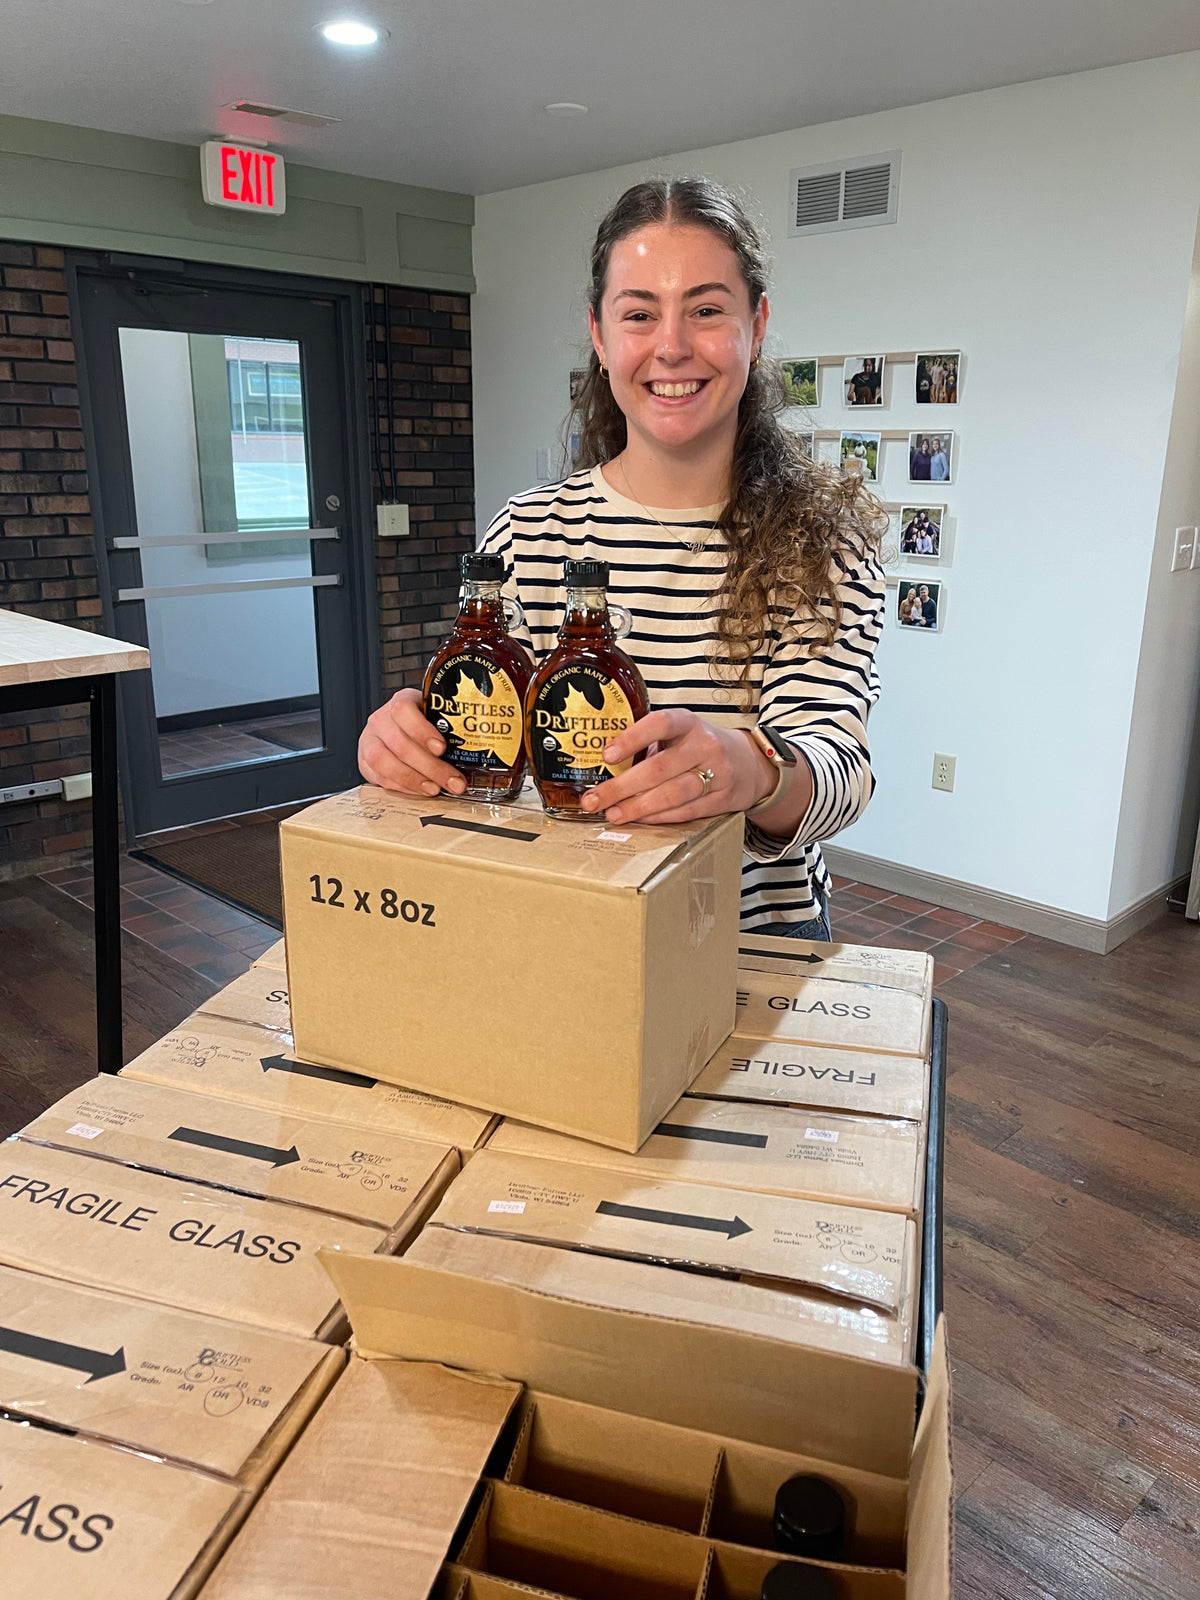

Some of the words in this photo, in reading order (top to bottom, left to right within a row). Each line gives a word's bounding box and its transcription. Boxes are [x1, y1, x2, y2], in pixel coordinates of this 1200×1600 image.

[220, 146, 276, 208] EXIT
[434, 669, 446, 685] PURE
[444, 654, 472, 670] ORGANIC
[474, 656, 497, 672] MAPLE
[496, 672, 512, 693] SYRUP
[539, 682, 552, 700] PURE
[551, 667, 581, 684] ORGANIC
[584, 668, 608, 683] MAPLE
[606, 683, 624, 704] SYRUP
[430, 692, 515, 717] DRIFTLESS
[535, 709, 628, 730] DRIFTLESS
[464, 716, 511, 734] GOLD
[572, 732, 613, 748] GOL
[310, 874, 344, 908] 12
[353, 889, 371, 914] x
[380, 888, 436, 927] 8oz
[768, 996, 871, 1019] GLASS
[729, 1058, 876, 1085] FRAGILE
[389, 1184, 407, 1192] VDS
[0, 1174, 158, 1231] FRAGILE
[169, 1219, 301, 1264] GLASS
[130, 1373, 162, 1385] Grade:
[178, 1383, 194, 1392] AR
[212, 1390, 230, 1400] DR
[246, 1397, 270, 1408] VDS
[140, 1361, 160, 1370] Size
[213, 1376, 226, 1384] 12
[236, 1380, 248, 1389] 16
[258, 1385, 272, 1394] 32
[0, 1494, 114, 1553] ASS
